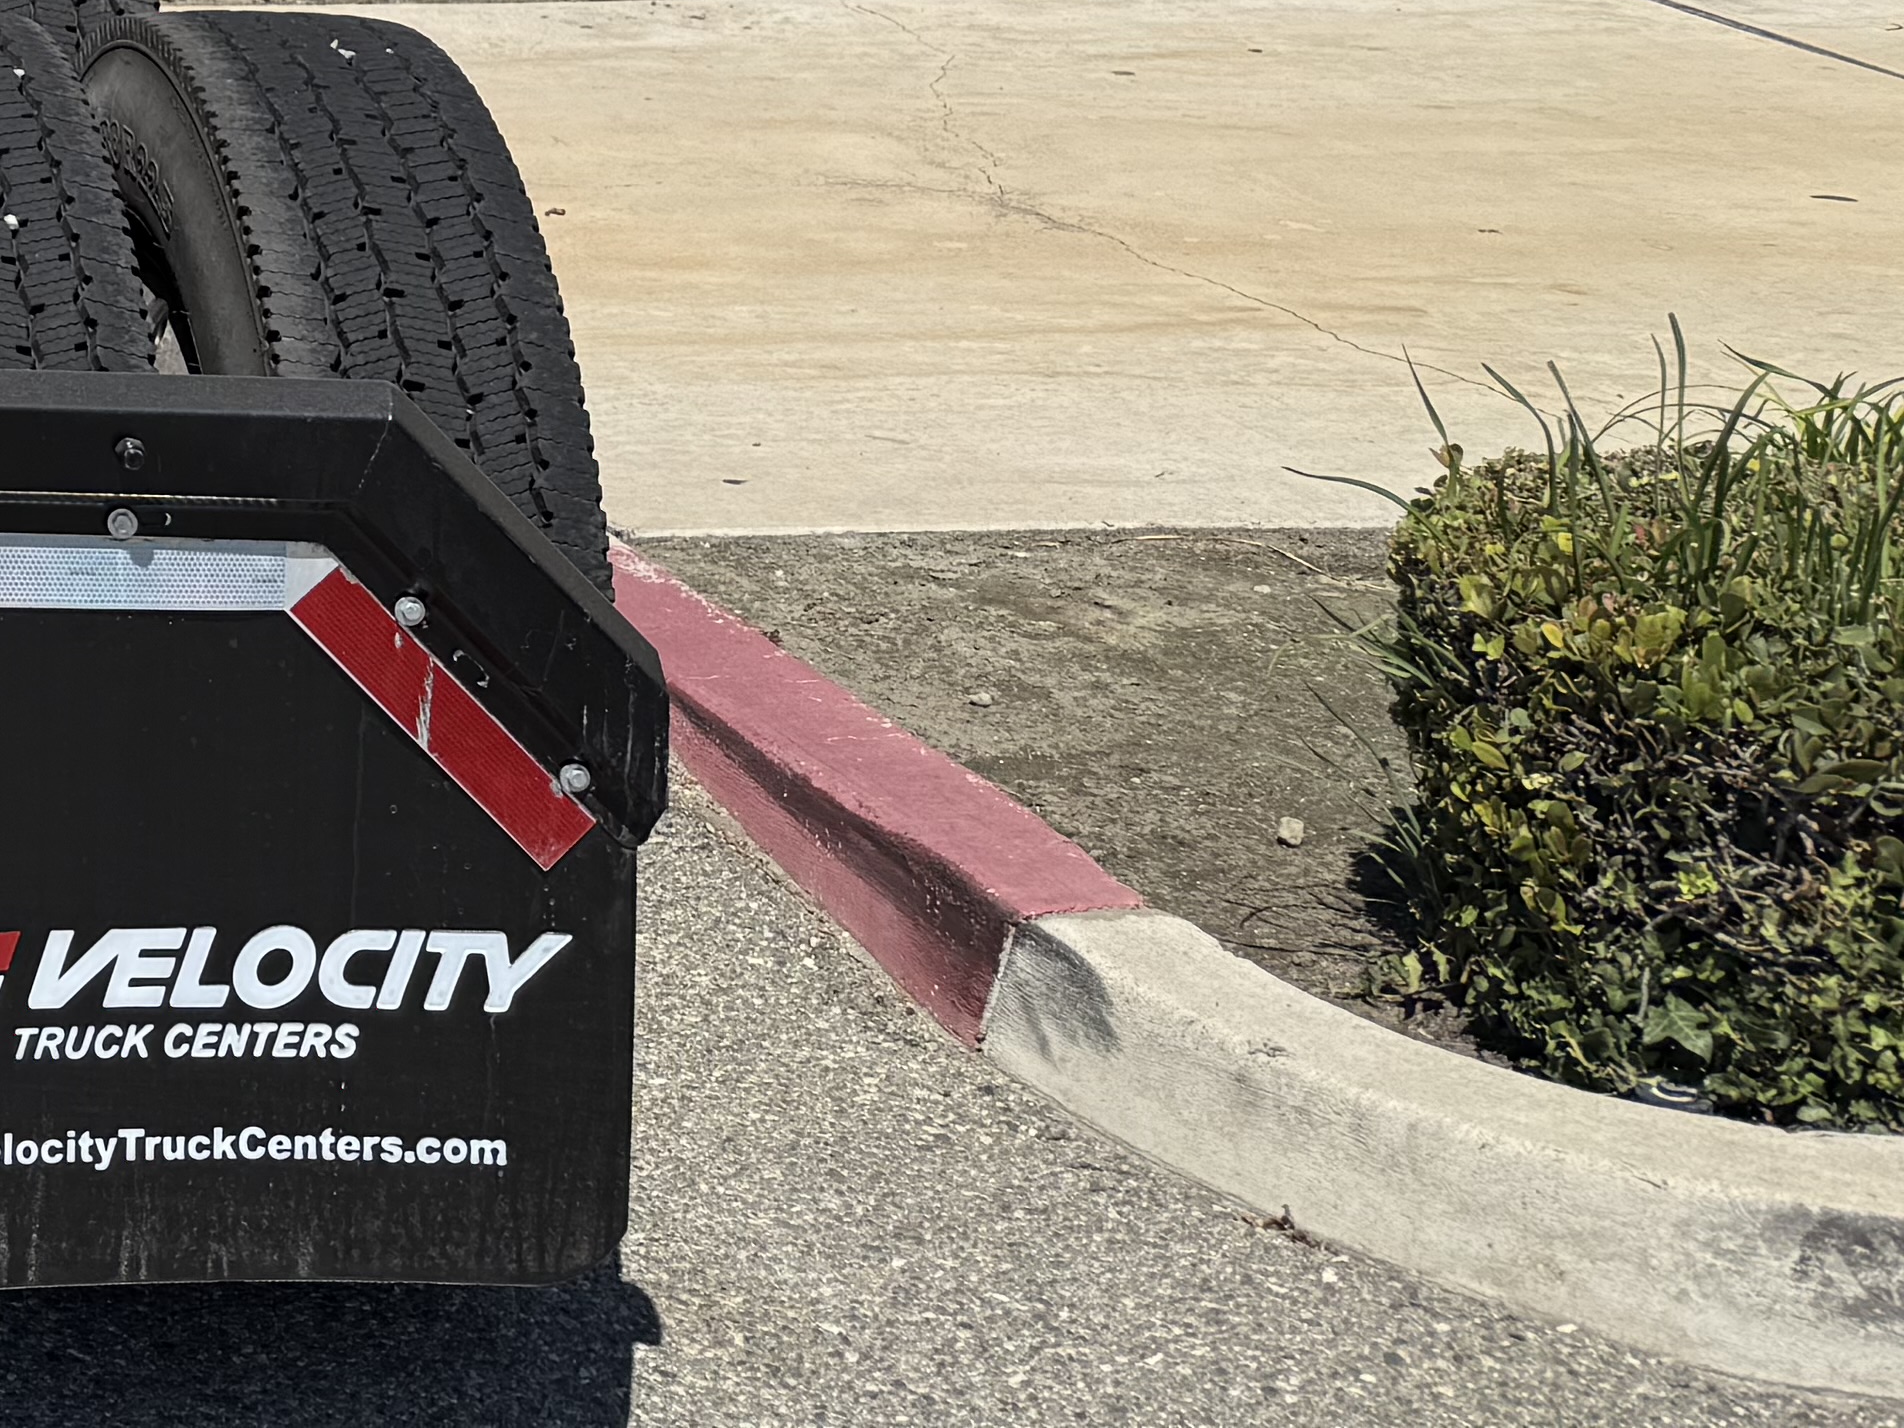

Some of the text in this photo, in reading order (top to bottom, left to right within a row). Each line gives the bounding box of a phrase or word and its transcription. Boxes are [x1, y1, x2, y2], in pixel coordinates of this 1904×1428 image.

[27, 924, 573, 1013] VELOCITY
[14, 1022, 360, 1061] TRUCK CENTERS
